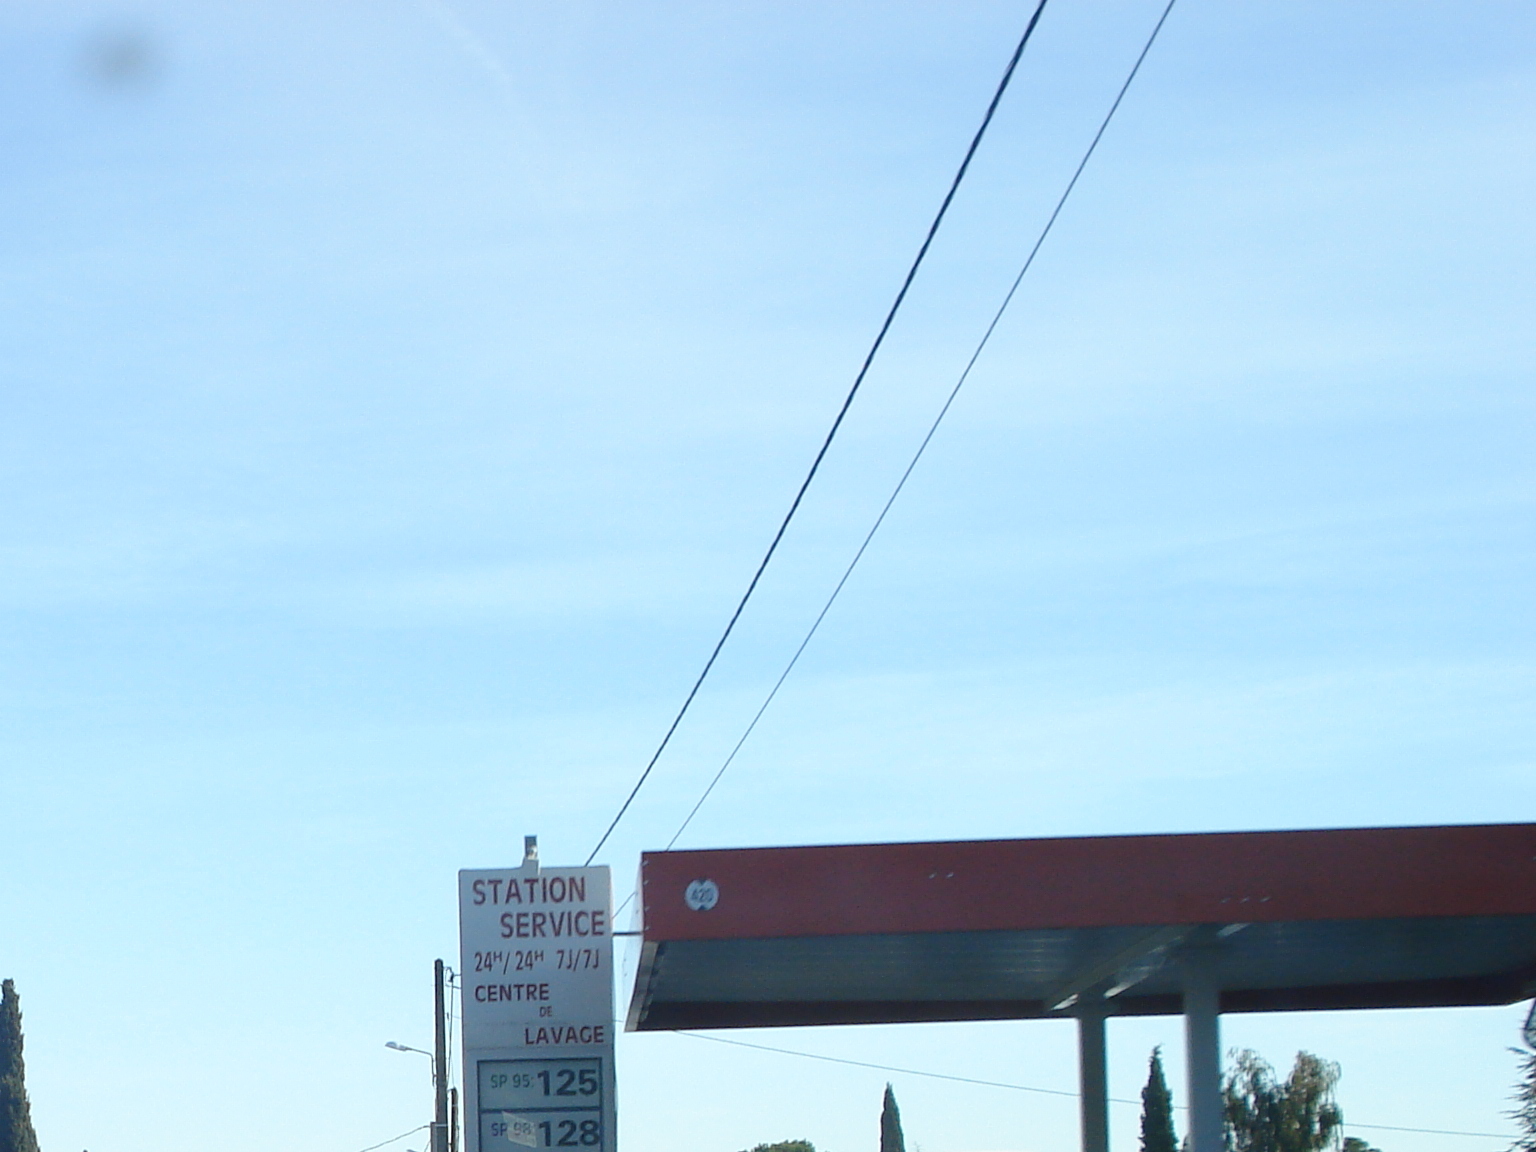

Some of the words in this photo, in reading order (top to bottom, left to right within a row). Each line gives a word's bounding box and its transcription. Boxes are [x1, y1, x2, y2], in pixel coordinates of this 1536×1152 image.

[472, 876, 586, 906] STATION
[500, 910, 605, 938] SERVICE
[474, 983, 550, 1003] CENTRE
[539, 1005, 553, 1018] DE
[524, 1025, 605, 1045] LAVAGE
[490, 1074, 508, 1089] SP
[491, 1122, 508, 1137] SP
[538, 1119, 601, 1147] 128
